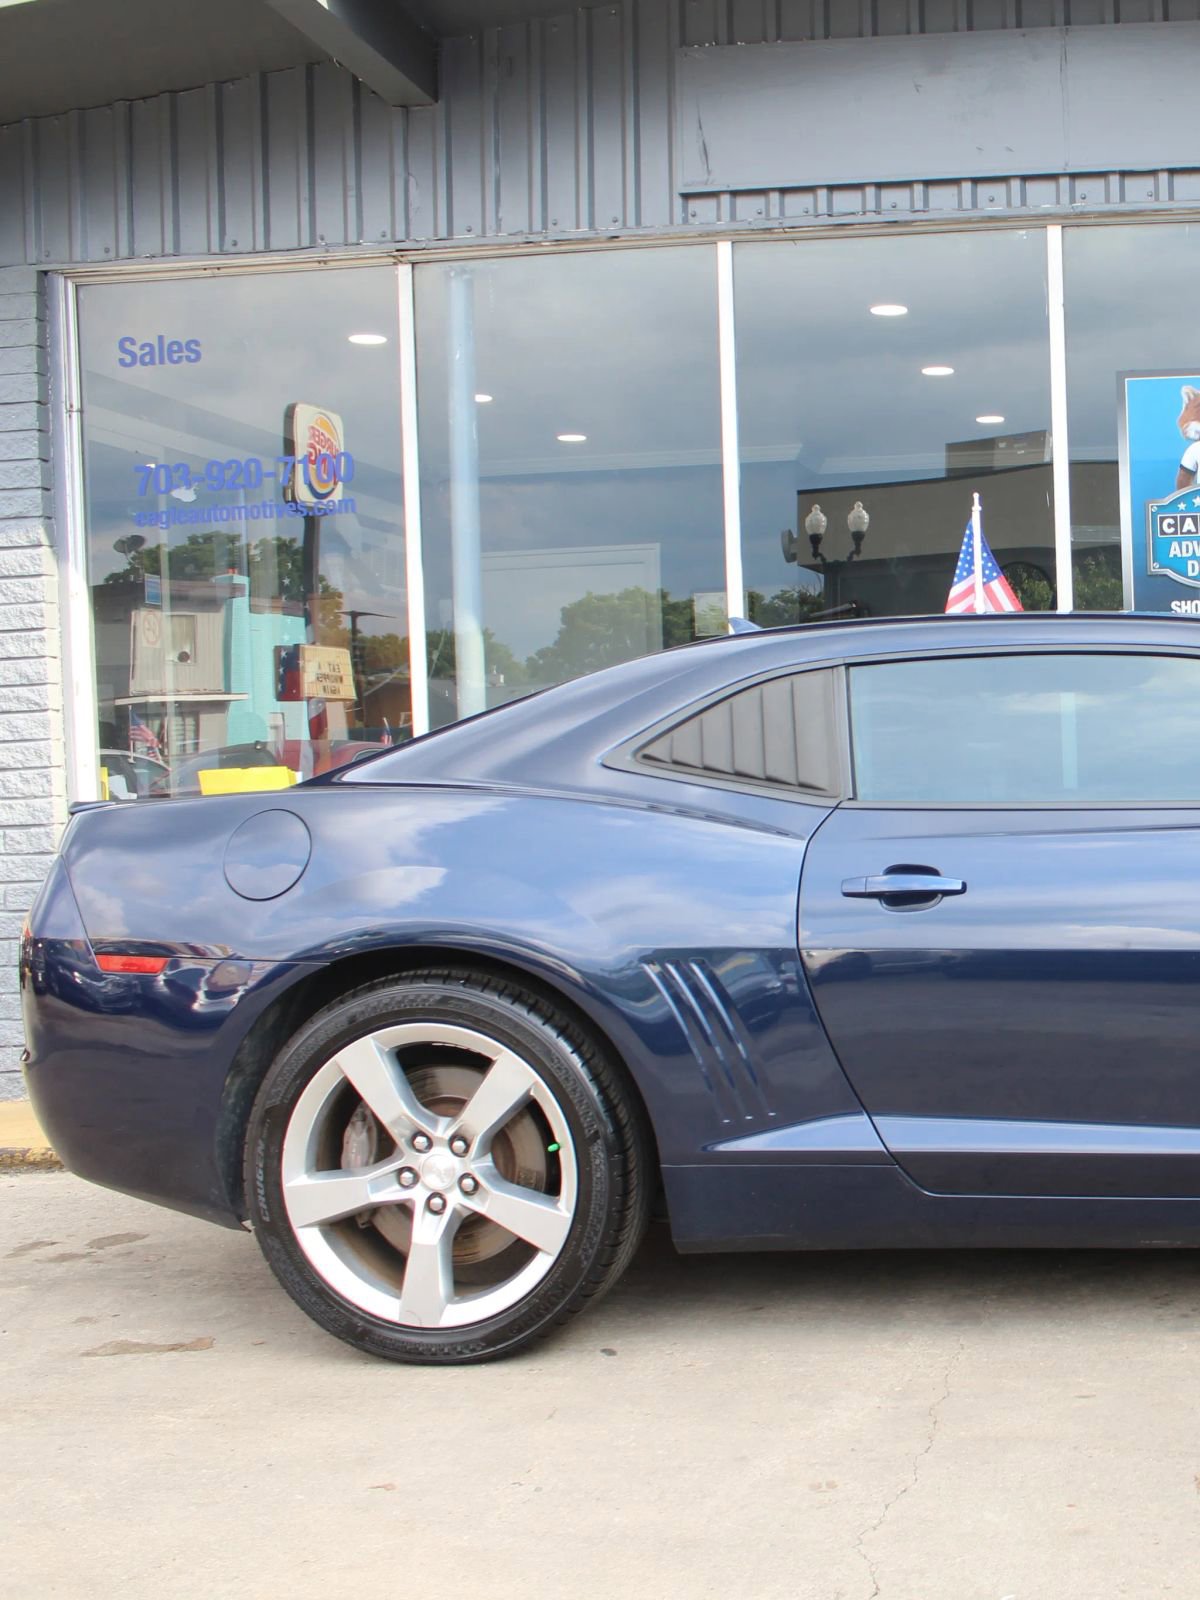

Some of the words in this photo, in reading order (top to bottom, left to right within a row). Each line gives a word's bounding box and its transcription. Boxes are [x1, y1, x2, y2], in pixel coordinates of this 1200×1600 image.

[118, 335, 202, 368] Sales
[133, 451, 355, 498] 703-920-7100
[134, 498, 357, 531] eagleautomotives.com
[256, 1139, 270, 1222] CRUGEN
